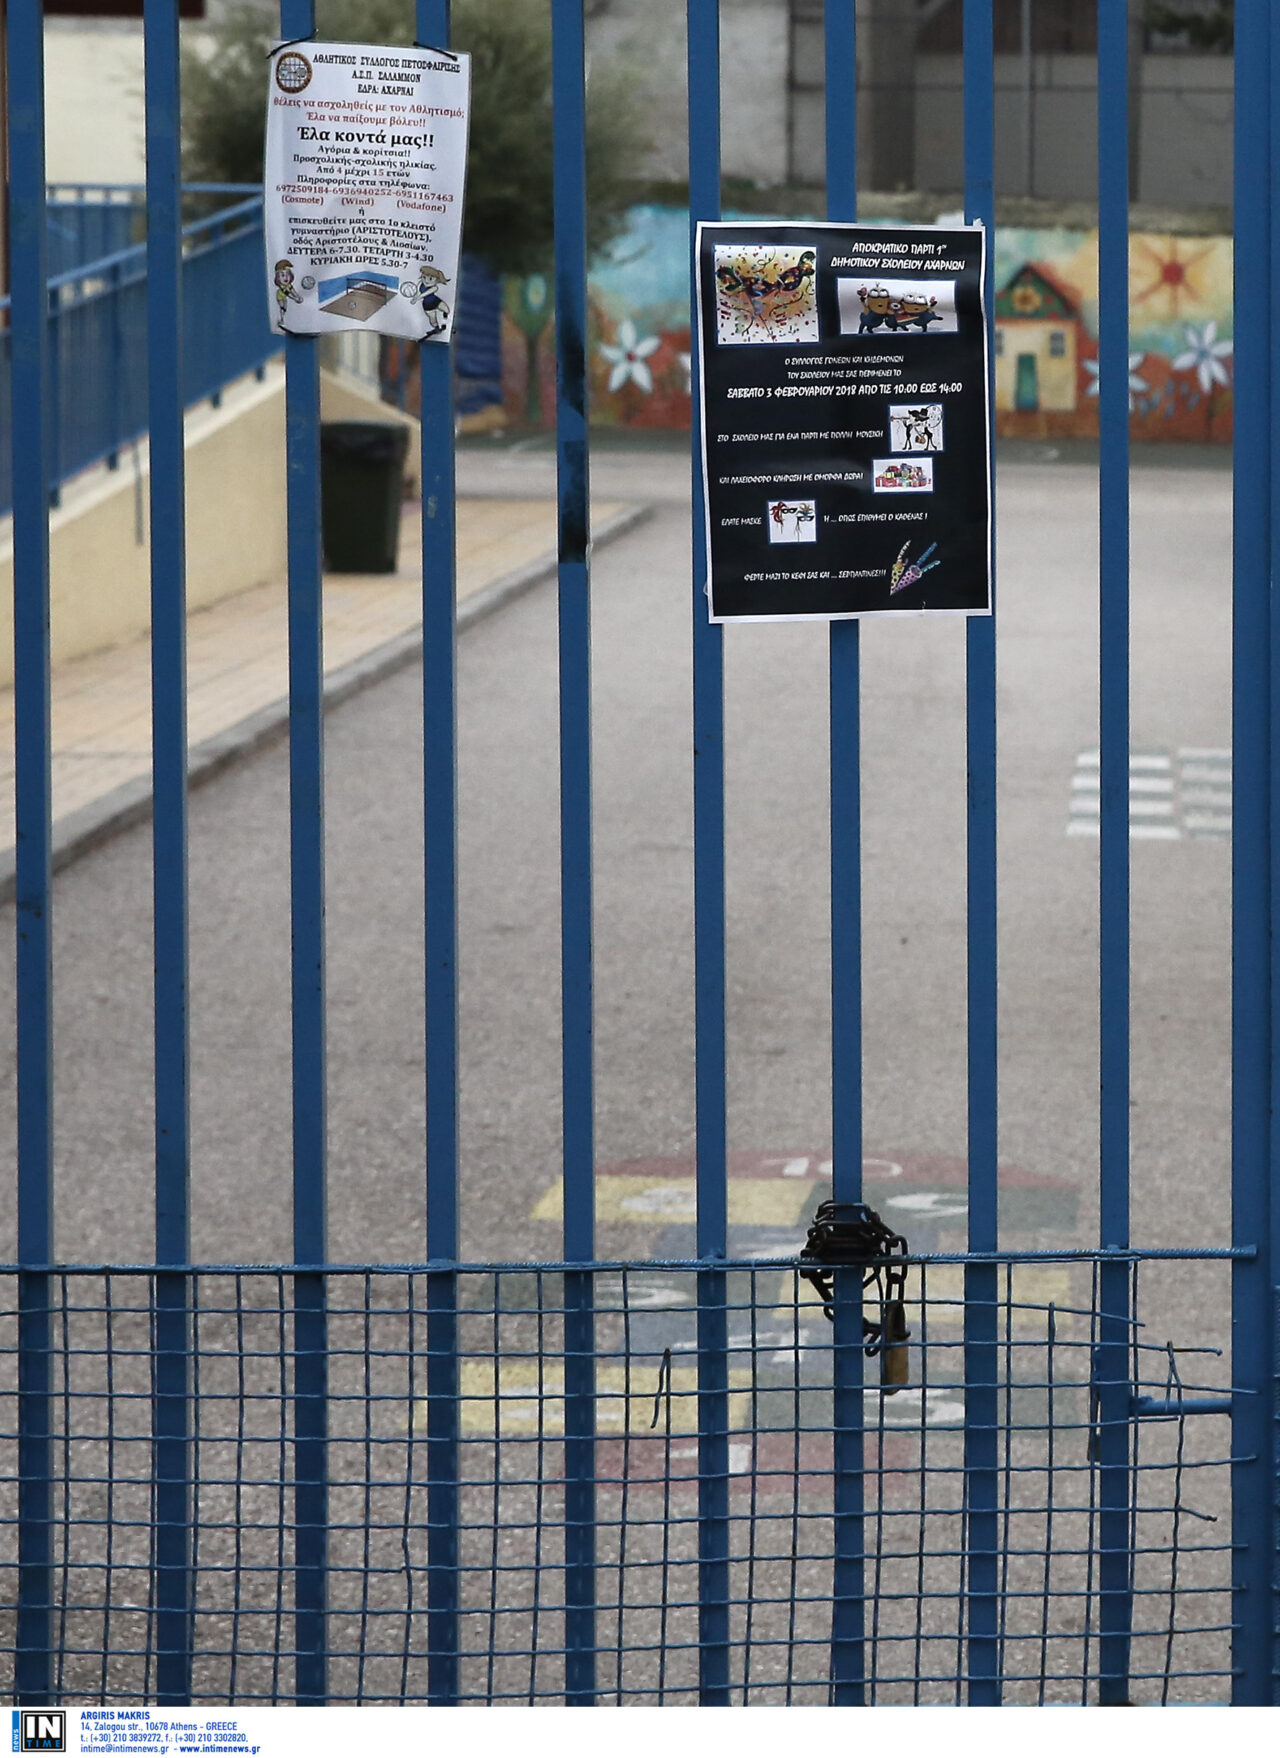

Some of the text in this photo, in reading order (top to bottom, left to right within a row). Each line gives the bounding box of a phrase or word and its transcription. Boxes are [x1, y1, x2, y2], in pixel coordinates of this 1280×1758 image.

[313, 54, 461, 73] ΑΘΛΗΤΙΚΟΣ ΣΥΛΛΟΓΟΣ ΠΕΤΟΣΦΑΙΡΙΣΗΣ
[352, 70, 421, 83] Α.Σ.Π. ΣΑΛΑΜΜΟΝ
[357, 84, 414, 96] ΕΔΡΑ: ΑΧΑΡΝΑΙ
[318, 99, 374, 112] ασχοληθείς
[376, 103, 388, 113] με
[390, 104, 407, 112] τον
[409, 104, 465, 119] Αθλητισμό;
[307, 111, 326, 121] Έλα
[343, 114, 388, 126] παίξουμε
[297, 126, 434, 150] Έλα κοντά μας!!
[318, 145, 411, 158] Αγόρια & κορίτσια!!
[316, 166, 335, 174] Από
[344, 167, 371, 177] μέχρι
[373, 169, 384, 177] 15
[386, 170, 411, 178] ετών
[297, 175, 357, 187] Πληροφορίες
[379, 179, 431, 191] τηλέφωνα:
[281, 195, 447, 214] (Cosmote) (Wind) (Vodafone)
[359, 207, 365, 216] ή
[289, 216, 347, 226] επισκευθείτε
[349, 217, 367, 226] μας
[369, 218, 386, 226] στο
[400, 221, 436, 232] κλειστό
[291, 226, 350, 237] γυμναστήριο
[293, 236, 314, 247] οδός
[315, 236, 380, 247] Αριστοτέλους
[381, 238, 388, 246] &
[287, 247, 327, 256] ΔΕΥΤΕΡΑ
[363, 246, 404, 258] ΤΕΤΑΡΤΗ
[405, 252, 434, 263] 3-4.30
[852, 242, 908, 254] ΑΠΟΚΡΙΑΤΙΚΟ
[911, 244, 935, 255] ΠΑΡΤΙ
[310, 255, 409, 269] ΚΥΡΙΑΚΗ ΩΡΕΣ 5.30-7
[830, 256, 966, 271] ΔΗΜΟΤΙΚΟΥ ΣΧΟΛΕΙΟΥ ΑΧΑΡΝΩΝ
[791, 356, 823, 366] ΣΥΛΛΟΓΟΣ
[824, 356, 851, 365] ΓΟΝΕΩΝ
[852, 356, 863, 364] ΚΑΙ
[788, 370, 799, 379] ΤΟΥ
[800, 370, 830, 379] ΣΧΟΛΕΙΟΥ
[832, 370, 844, 378] ΜΑΣ
[845, 370, 857, 378] ΣΑΣ
[893, 369, 902, 377] ΤΟ
[727, 382, 963, 399] ΣΑΒΒΑΤΟ 3 ΦΕΒΡΟΥΑΡΙΟΥ 2018 ΑΠΟ ΤΙΣ 10:00 ΕΩΣ 14:00
[717, 434, 729, 442] ΣΤΟ
[732, 433, 759, 442] ΣΧΟΛΕΙΟ
[760, 433, 774, 441] ΜΑΣ
[800, 431, 819, 440] ΠΑΡΤΙ
[820, 431, 829, 439] ΜΕ
[721, 517, 740, 526] ΕΛΑΤΕ
[782, 572, 790, 580] ΤΟ
[807, 571, 818, 579] ΣΑΣ
